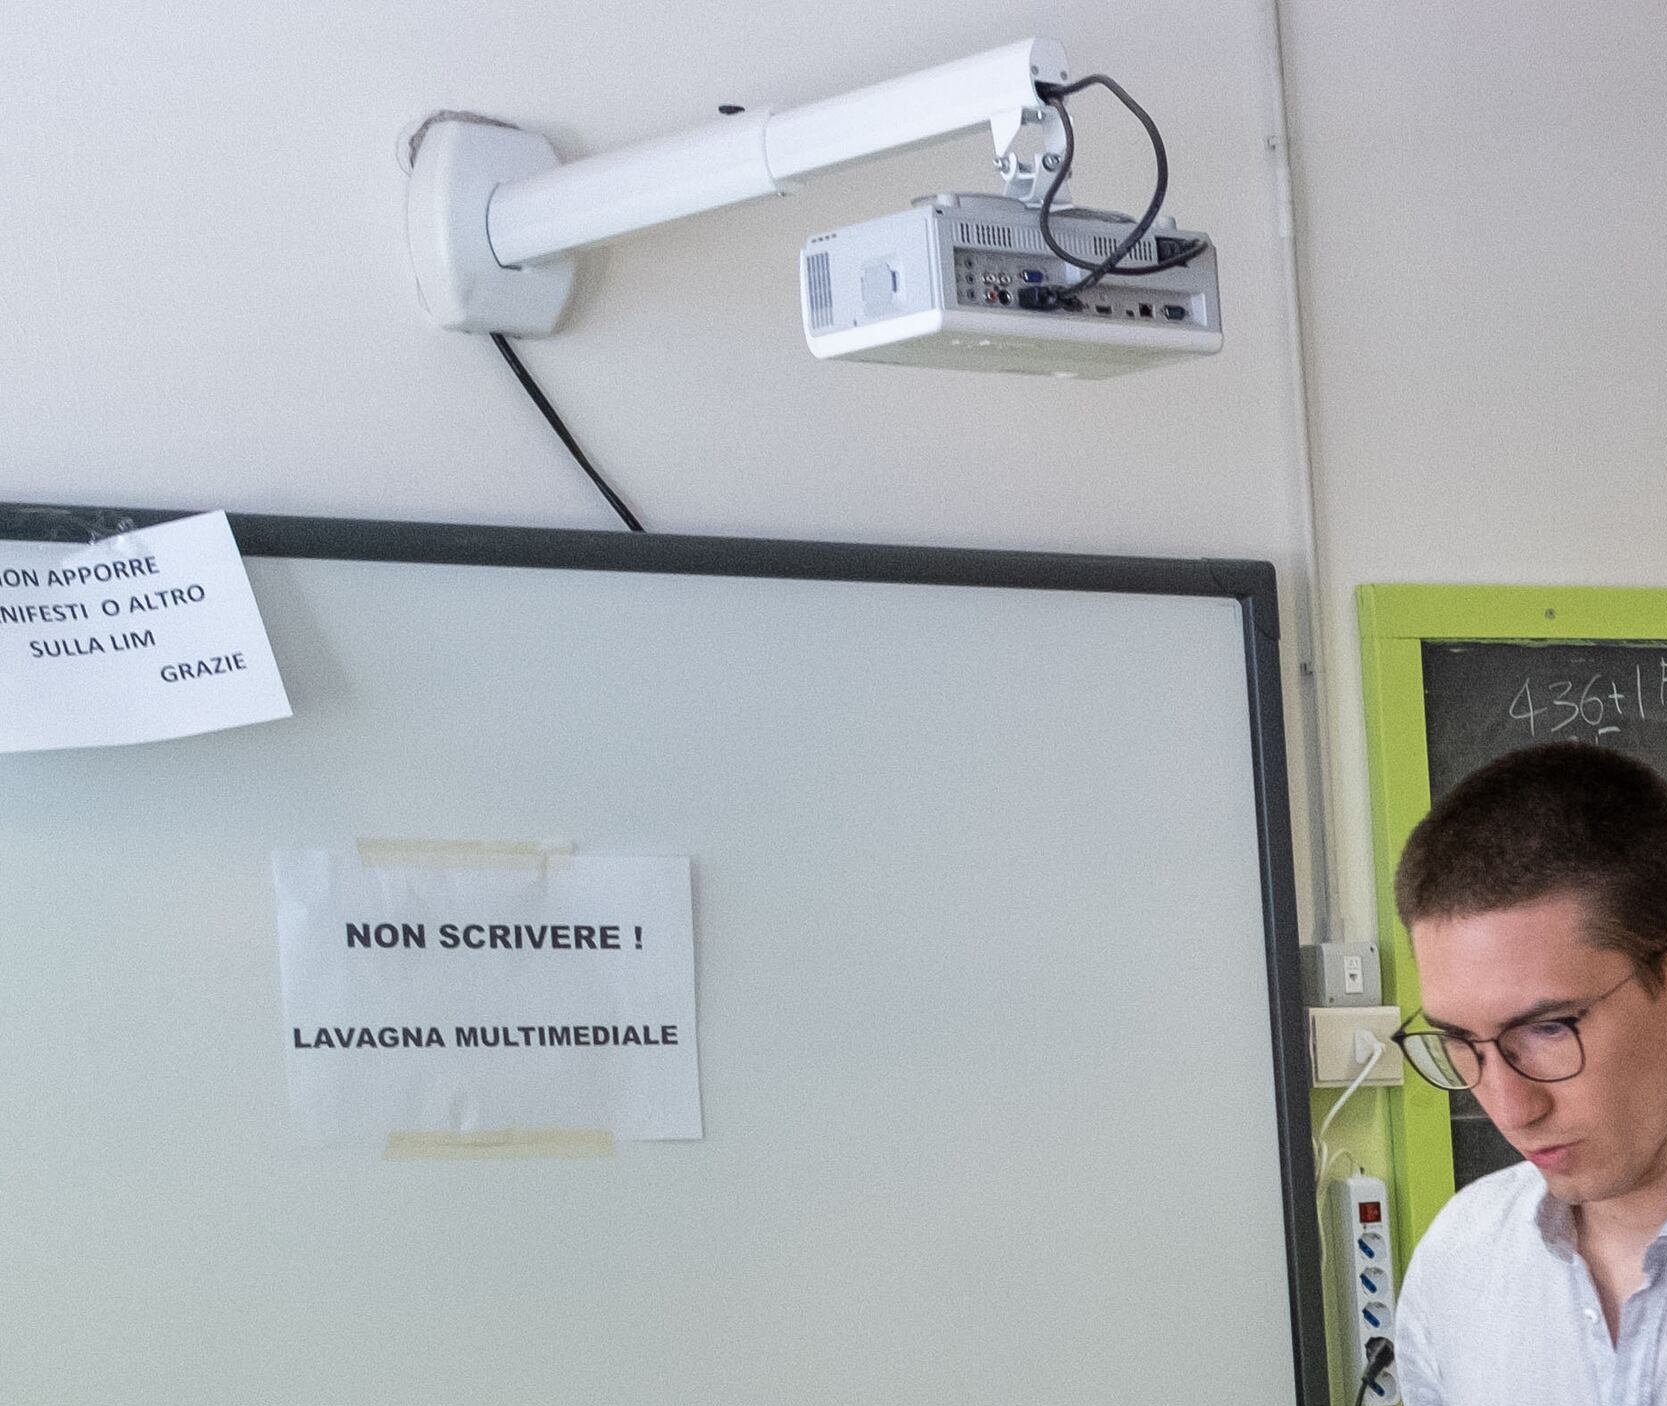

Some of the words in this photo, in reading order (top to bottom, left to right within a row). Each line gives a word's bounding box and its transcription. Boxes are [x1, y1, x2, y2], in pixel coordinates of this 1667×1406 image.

[0, 568, 40, 588] ON
[47, 556, 161, 588] APPORRE
[0, 602, 89, 625] NIFESTI
[101, 598, 120, 617] O
[128, 584, 206, 613] ALTRO
[29, 636, 106, 659] SULLA
[109, 629, 157, 651] LIM
[160, 652, 248, 683] GRAZIE
[345, 922, 426, 950] NON
[438, 923, 622, 951] SCRIVERE
[292, 1026, 446, 1050] LAVAGNA
[455, 1024, 680, 1048] MULTIMEDIALE
